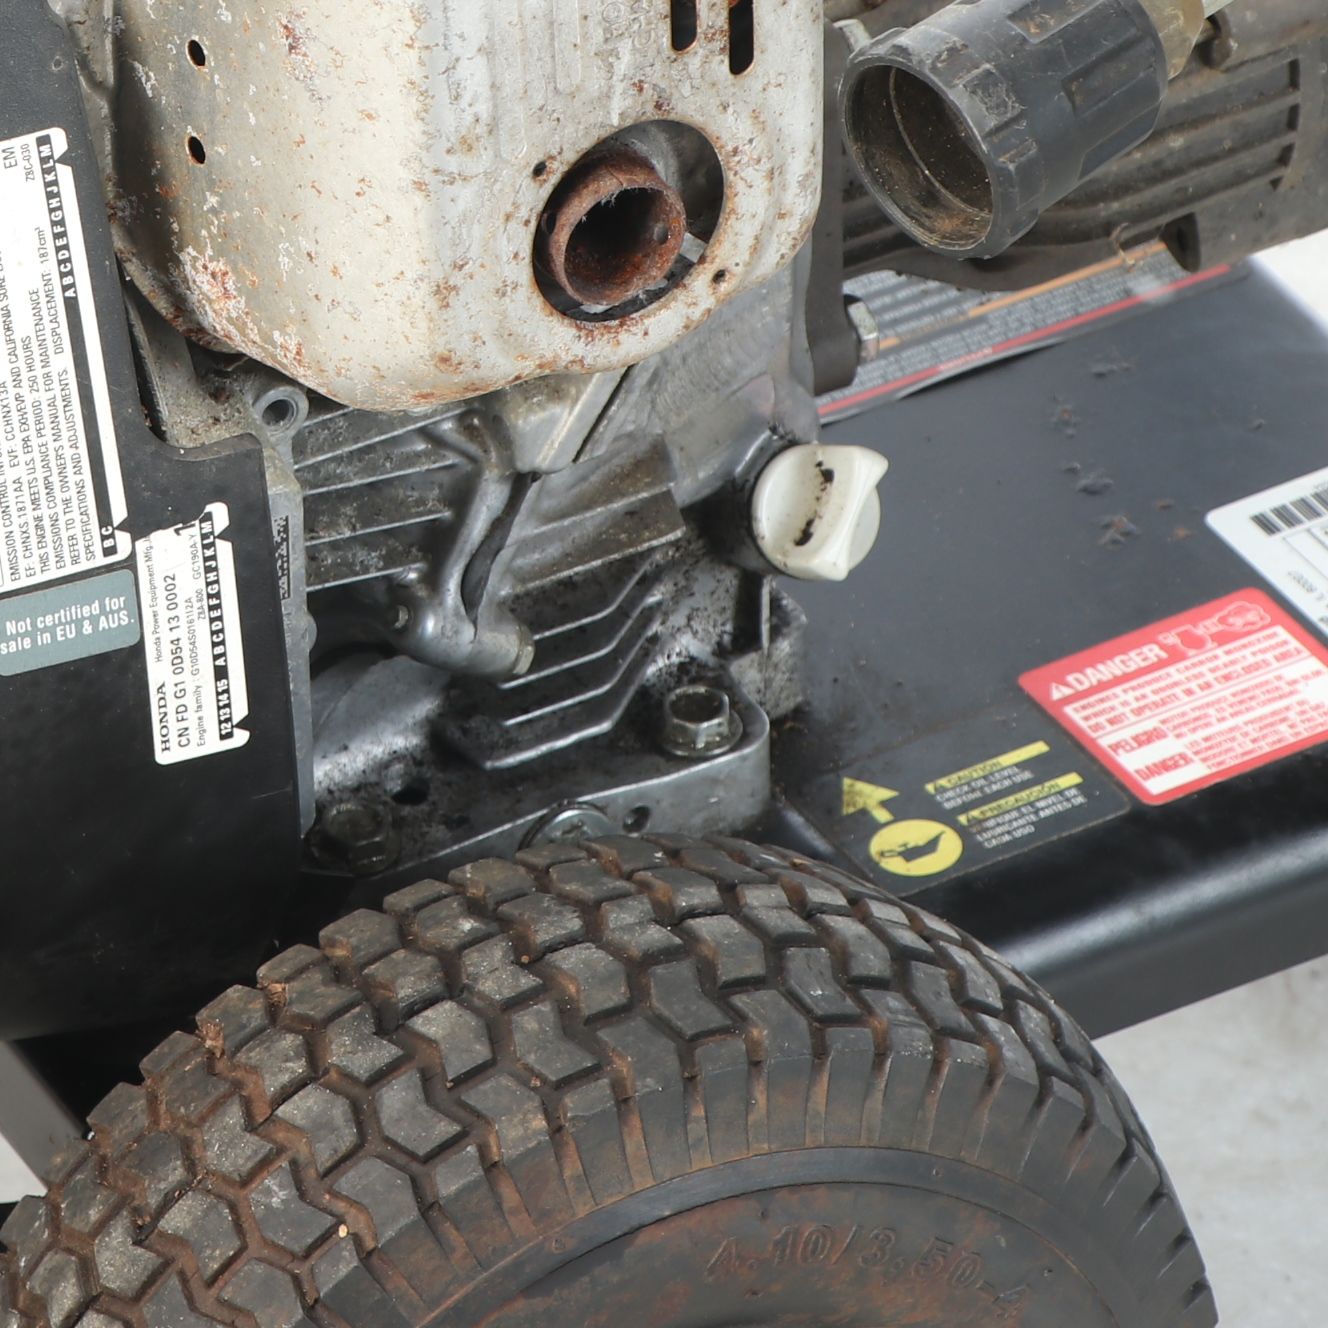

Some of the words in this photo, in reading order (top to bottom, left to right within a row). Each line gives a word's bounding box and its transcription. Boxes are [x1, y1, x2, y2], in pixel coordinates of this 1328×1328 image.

[1, 146, 17, 169] EM
[28, 287, 50, 369] MAINTENANCE
[41, 272, 64, 354] DISPLACEMENT:
[0, 303, 18, 364] CALIFORNIA
[20, 335, 35, 372] HOURS
[10, 366, 22, 388] AND
[27, 374, 39, 393] 250
[42, 370, 54, 392] FOR
[14, 392, 29, 433] EXH/EVP
[31, 399, 46, 438] PERIOD:
[46, 393, 62, 442] MANUAL
[57, 368, 79, 449] ADJUSTMENTS.
[6, 448, 19, 468] EVF:
[21, 434, 33, 454] EPA
[24, 456, 36, 475] U.S.
[37, 440, 57, 509] COMPLIANCE
[53, 444, 70, 493] OWNER'S
[70, 452, 83, 475] AND
[27, 476, 41, 511] MEETS
[61, 495, 73, 516] THE
[11, 476, 33, 559] CHNXS.1871AA
[32, 513, 47, 550] ENGINE
[64, 517, 75, 531] TO
[74, 478, 96, 561] SPECIFICATIONS
[4, 530, 21, 581] EMISSION
[48, 511, 66, 569] EMISSIONS
[67, 533, 81, 565] REFER
[24, 565, 36, 577] EF:
[38, 551, 50, 574] THIS
[144, 562, 159, 609] Equipment
[162, 571, 179, 612] 0002
[5, 616, 32, 636] Not
[35, 599, 100, 629] certified
[104, 593, 126, 612] for
[36, 629, 51, 646] in
[55, 622, 76, 641] EU
[81, 618, 92, 635] &
[98, 607, 134, 631] AUS.
[149, 608, 161, 635] Power
[167, 613, 181, 633] 13
[152, 634, 164, 663] Honda
[215, 676, 229, 693] 15
[1065, 643, 1169, 693] DANGER
[172, 679, 187, 701] G1
[190, 682, 205, 714] family
[217, 691, 230, 707] 14
[153, 680, 172, 754] HONDA
[174, 701, 189, 724] FD
[218, 705, 231, 721] 13
[219, 719, 232, 735] 12
[1107, 712, 1130, 728] NOT
[1131, 694, 1181, 718] OPERATE
[176, 724, 191, 749] CN
[193, 713, 208, 747] Engine
